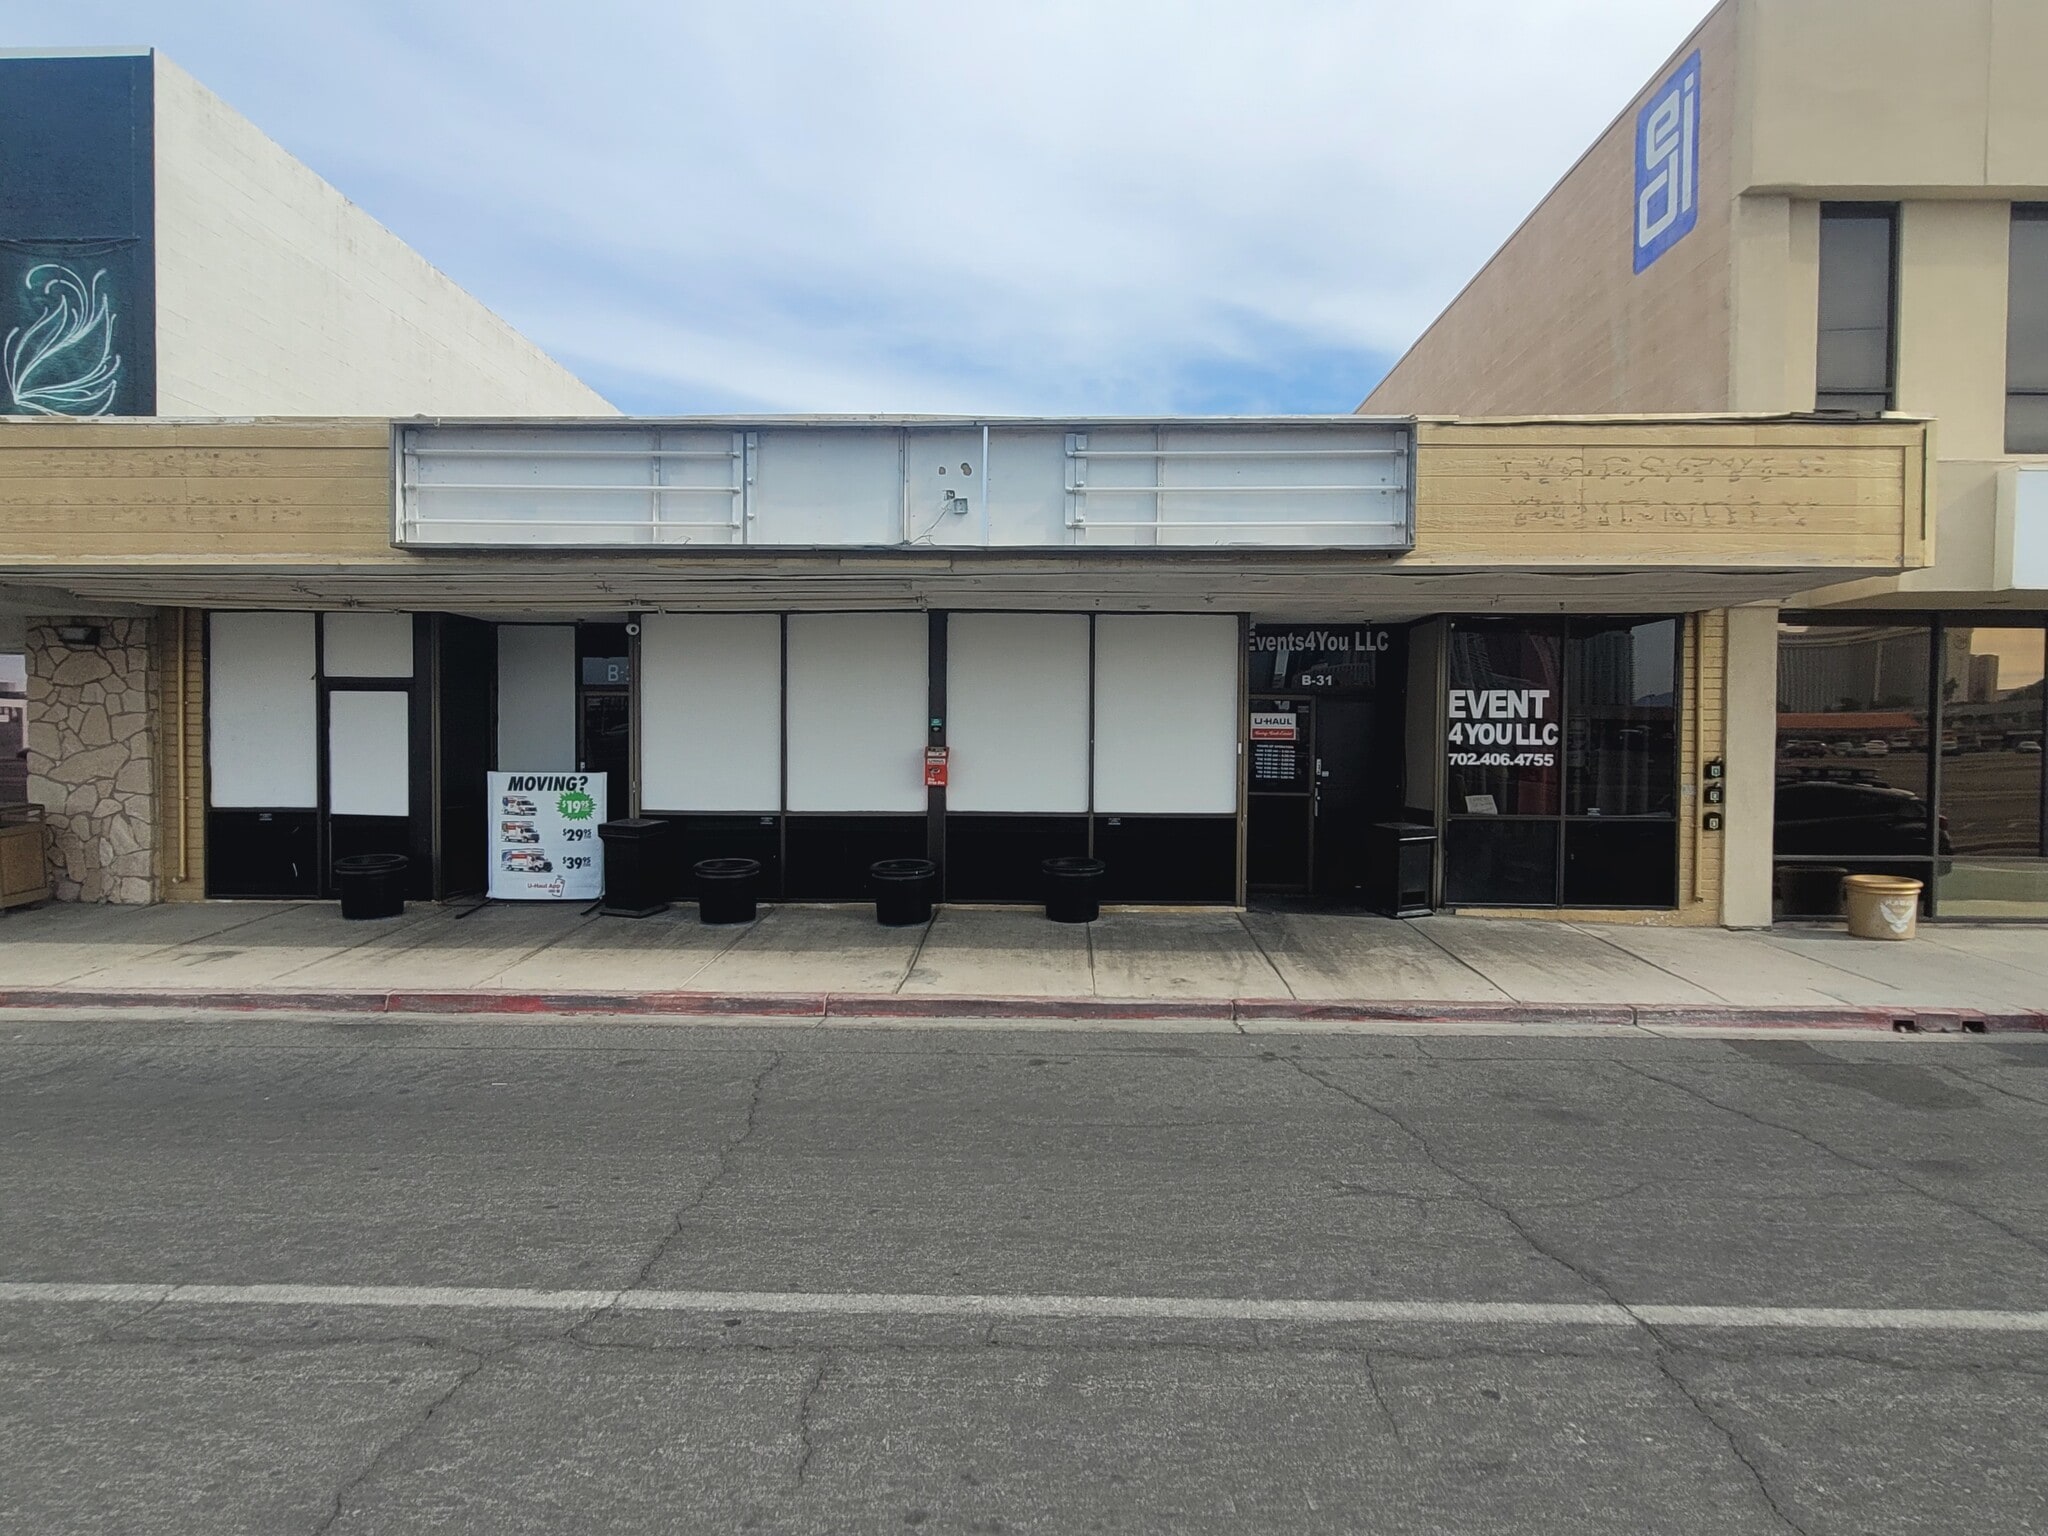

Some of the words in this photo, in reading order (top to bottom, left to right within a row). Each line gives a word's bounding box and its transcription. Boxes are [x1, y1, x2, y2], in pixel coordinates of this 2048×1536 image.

[1355, 631, 1389, 651] LLC
[607, 664, 630, 682] B-
[1301, 675, 1333, 686] B-31
[1448, 689, 1550, 719] EVENT
[1254, 717, 1293, 725] U-HAUL
[1448, 753, 1554, 767] 702.406.4755
[507, 775, 589, 792] MOVING?
